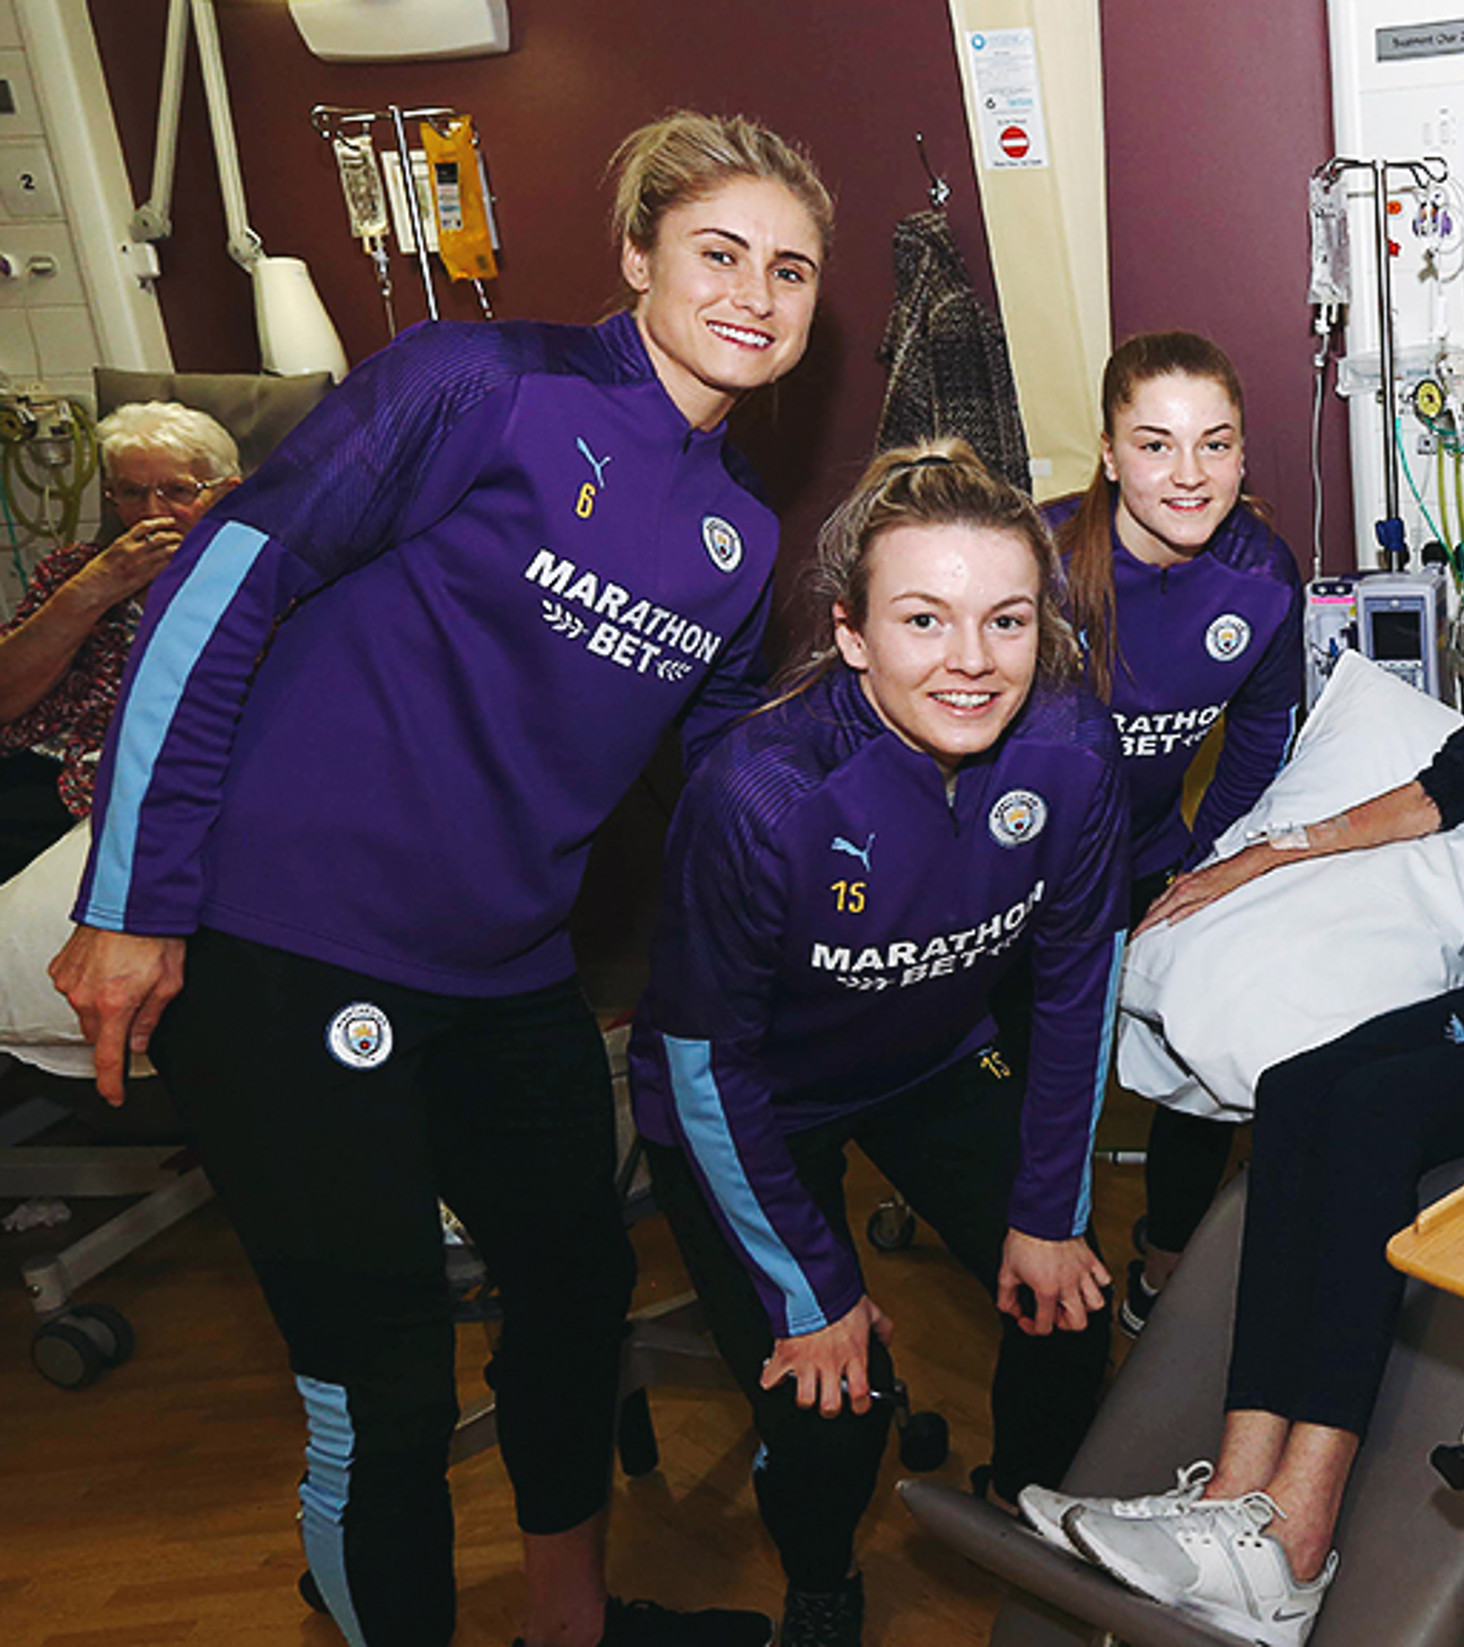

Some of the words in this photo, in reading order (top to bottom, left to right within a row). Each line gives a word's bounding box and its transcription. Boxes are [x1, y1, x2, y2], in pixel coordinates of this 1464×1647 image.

[20, 173, 36, 190] 2
[575, 482, 597, 519] 6
[524, 549, 722, 664] MARATHON
[587, 621, 662, 674] BET
[830, 880, 867, 913] 15
[810, 879, 1045, 973] MARATHON
[900, 945, 987, 988] BET
